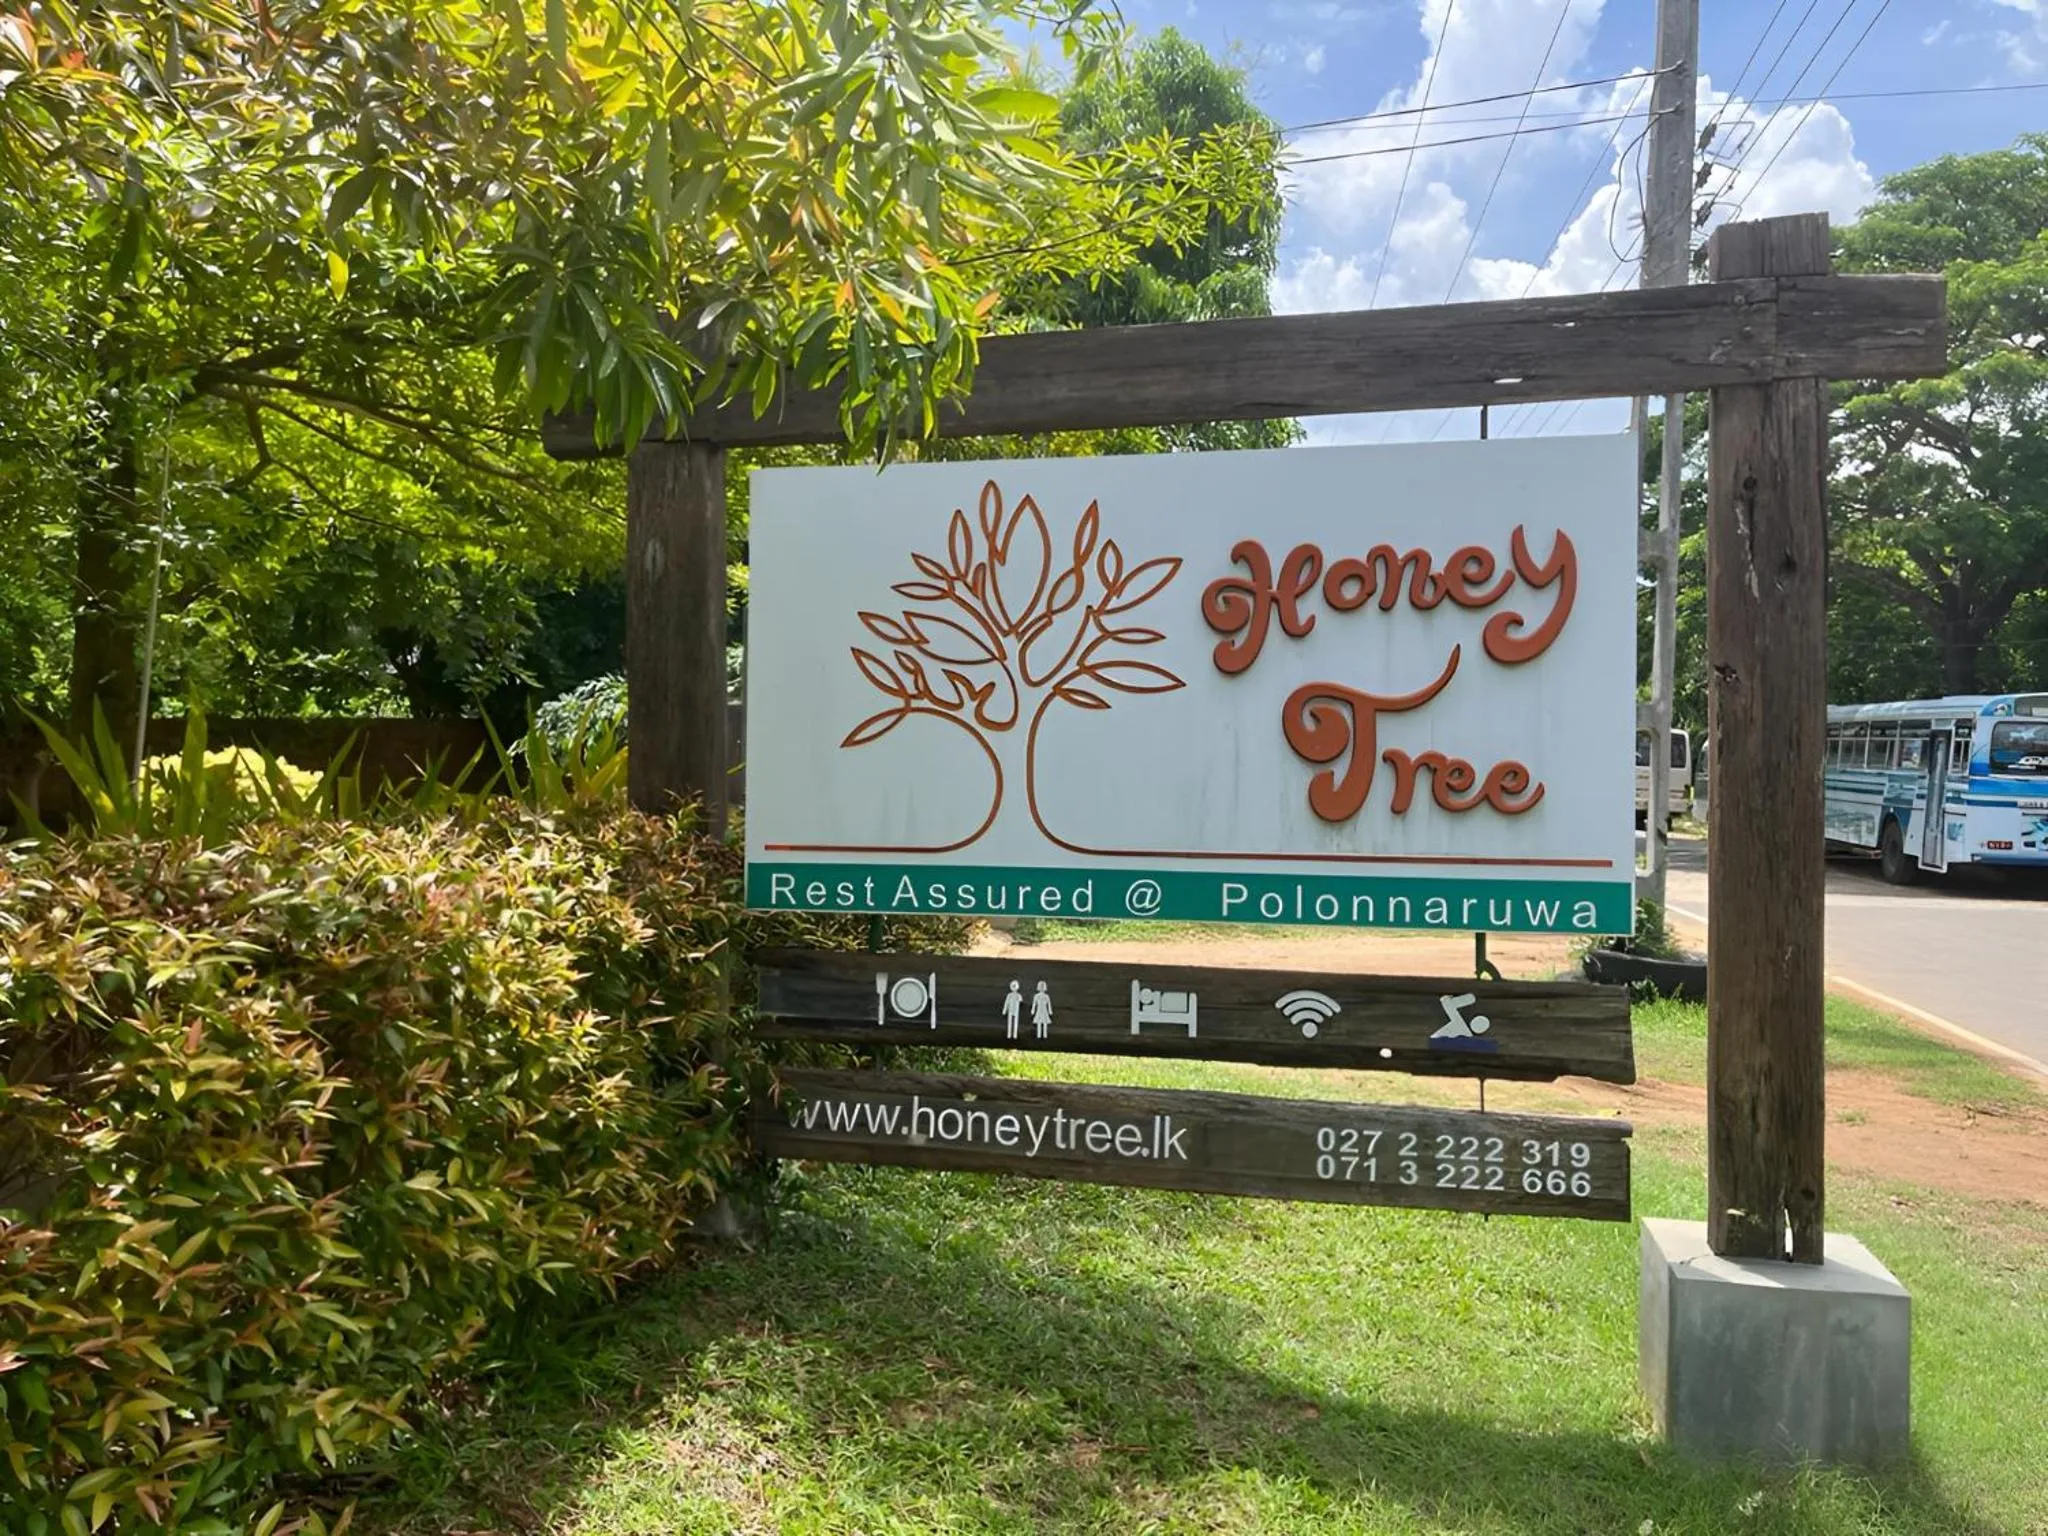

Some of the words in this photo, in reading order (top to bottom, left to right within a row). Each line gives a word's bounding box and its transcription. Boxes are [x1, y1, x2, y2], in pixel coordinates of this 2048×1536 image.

[1201, 523, 1578, 674] Honey
[1282, 642, 1545, 822] Tree
[771, 873, 876, 907] Rest
[892, 875, 1094, 913] Assured
[1125, 879, 1162, 916] @
[1222, 882, 1599, 929] Polonnaruwa
[790, 1096, 1189, 1160] www.honeytree.lk
[1317, 1127, 1382, 1156] 027
[1398, 1132, 1418, 1157] 2
[1435, 1135, 1504, 1163] 222
[1521, 1140, 1591, 1168] 319
[1317, 1154, 1378, 1182] 071
[1400, 1160, 1418, 1185] 3
[1435, 1163, 1504, 1190] 222
[1522, 1168, 1592, 1197] 666
